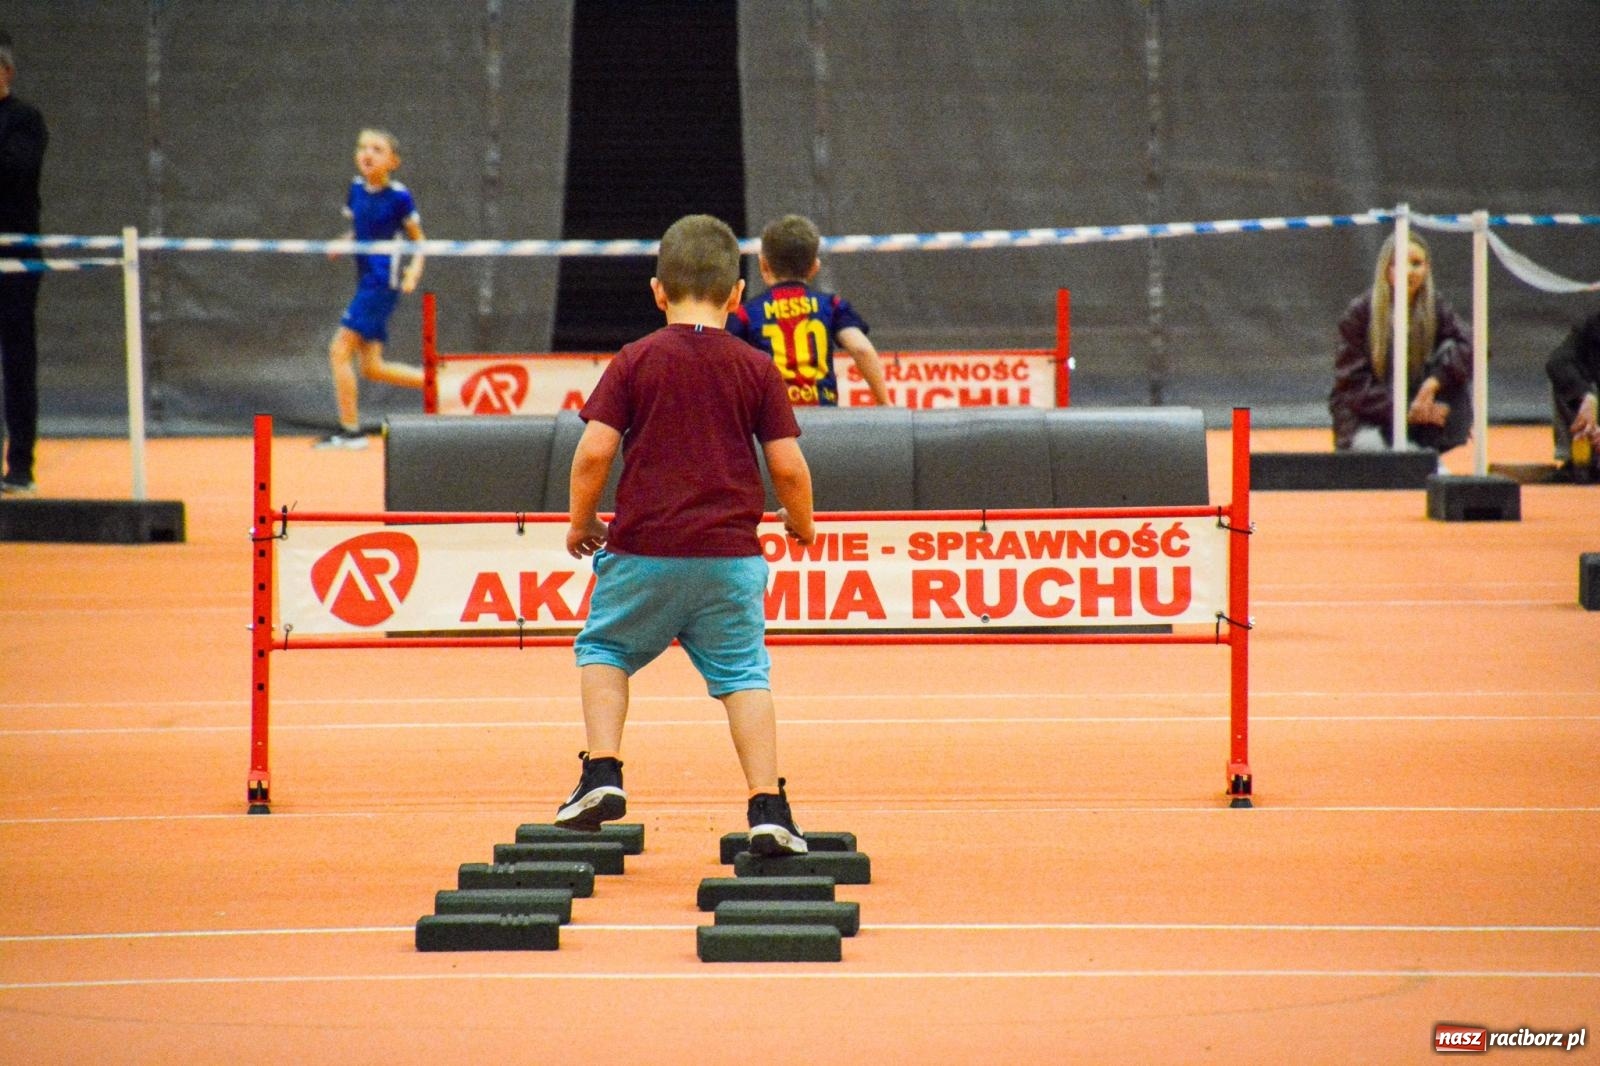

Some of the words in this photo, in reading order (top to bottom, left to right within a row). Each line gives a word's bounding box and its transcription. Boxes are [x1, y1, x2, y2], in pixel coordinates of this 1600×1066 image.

[764, 297, 818, 319] MESSI
[762, 319, 828, 379] 10
[847, 361, 1029, 382] SRAWNOŚĆ
[760, 532, 869, 562] OWIE
[908, 522, 1191, 561] SPRAWNOŚĆ
[912, 566, 1192, 620] RUCHU
